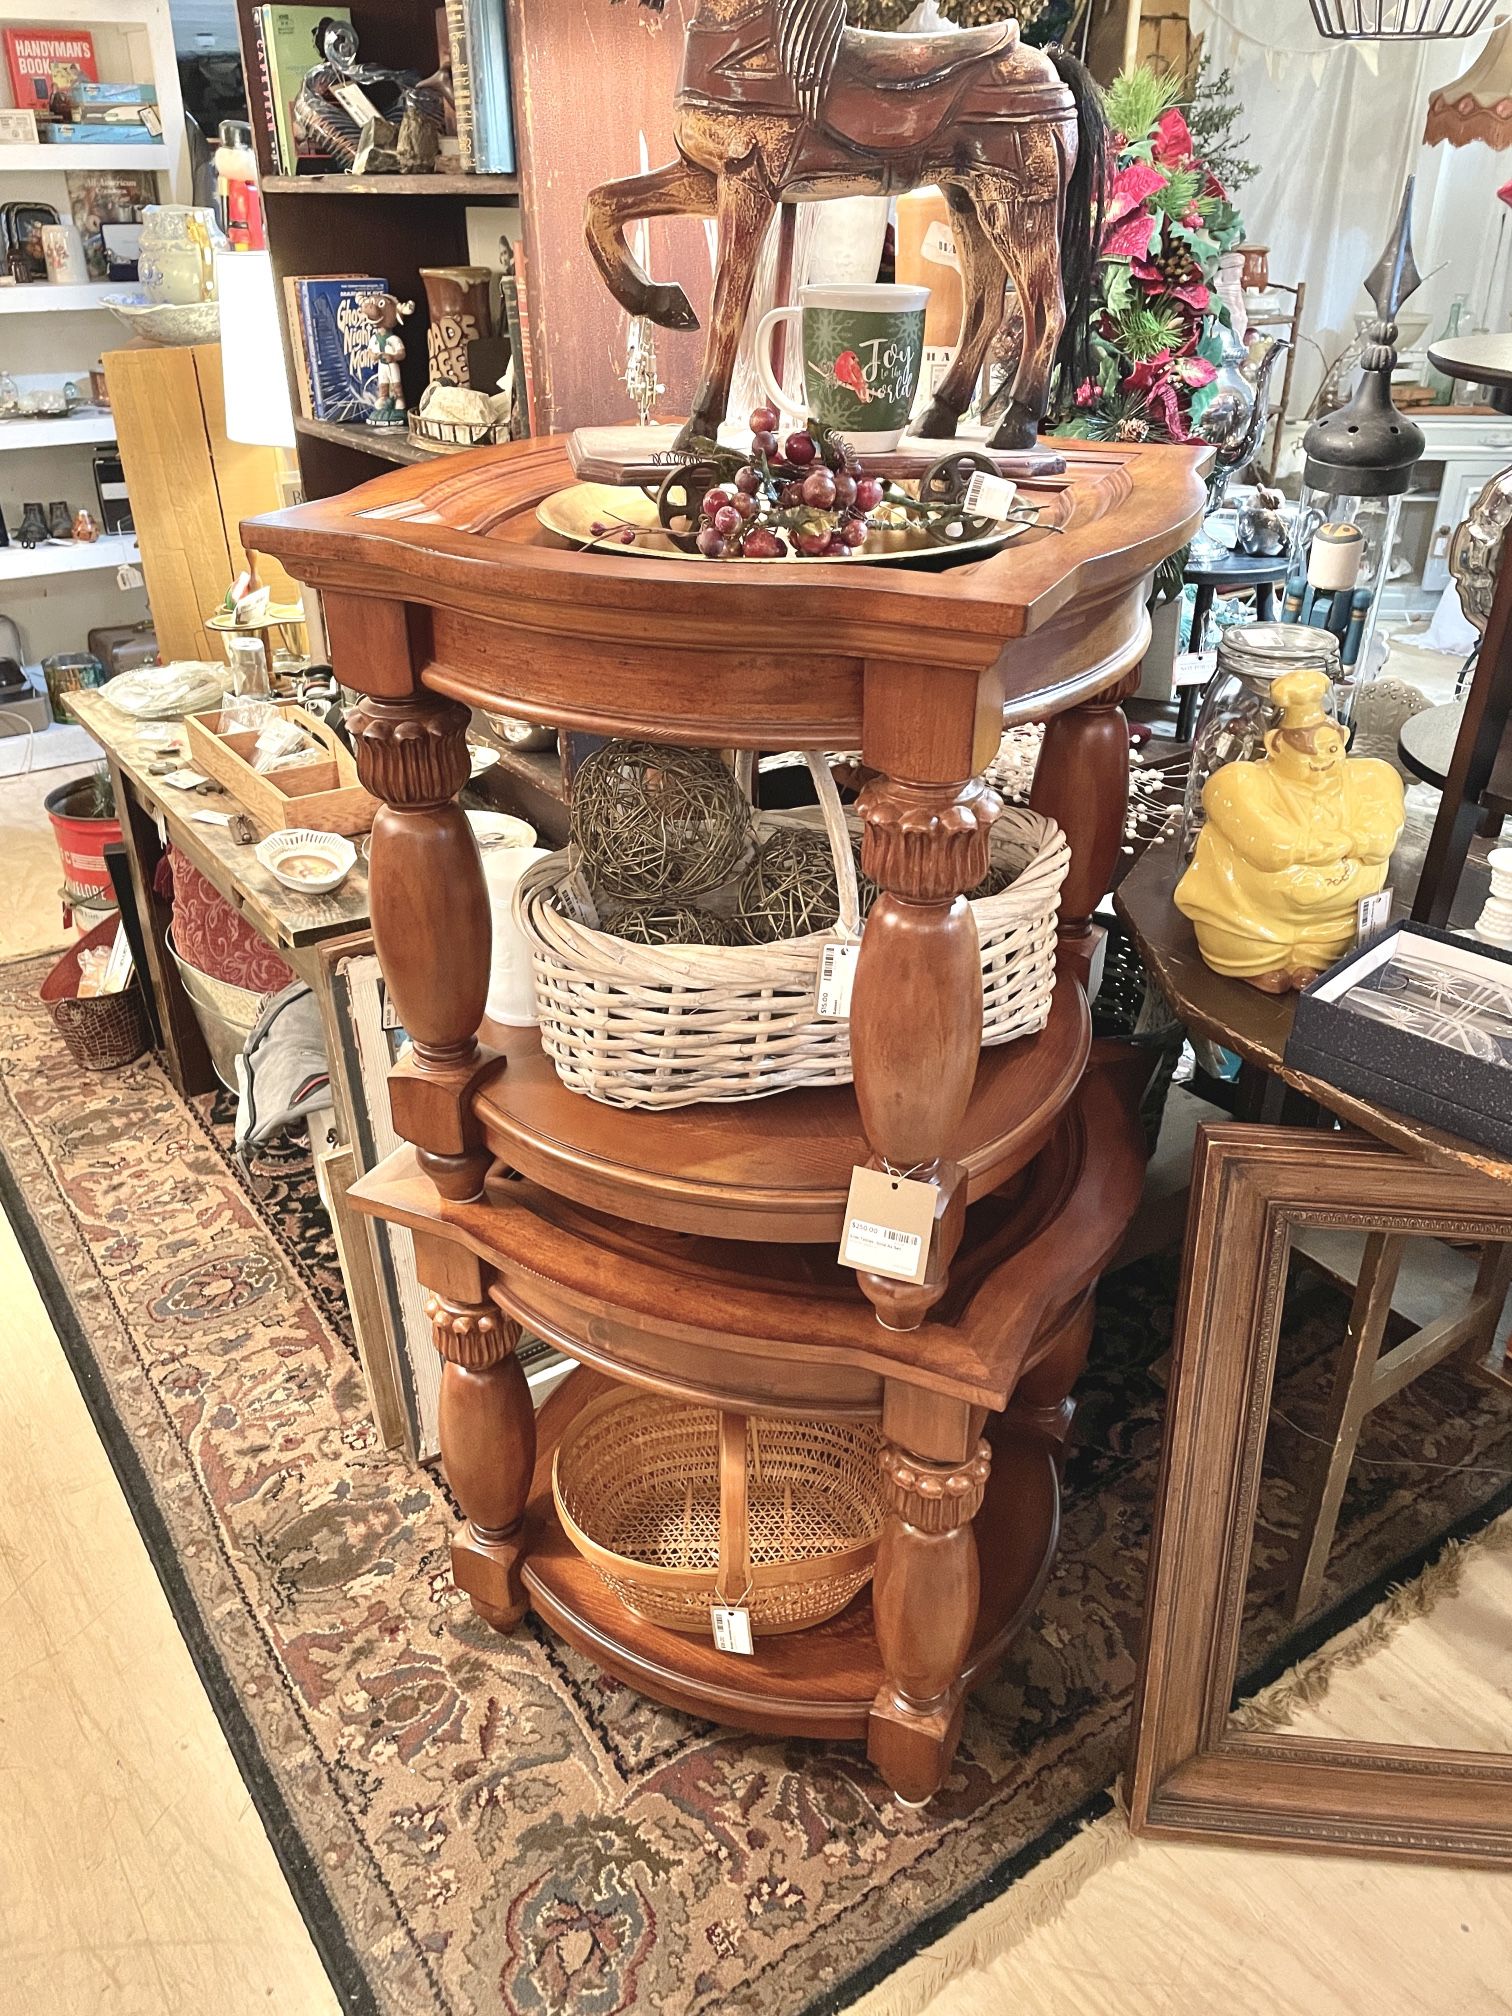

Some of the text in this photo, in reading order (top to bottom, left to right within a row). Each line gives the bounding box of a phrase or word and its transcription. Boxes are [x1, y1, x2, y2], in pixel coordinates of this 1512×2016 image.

[15, 39, 91, 58] HANDYMAN'S
[18, 57, 51, 75] BOOK
[256, 39, 269, 82] CAPE
[263, 90, 276, 131] FEAR
[859, 339, 914, 385] Joy
[881, 369, 888, 380] to
[866, 372, 913, 404] world
